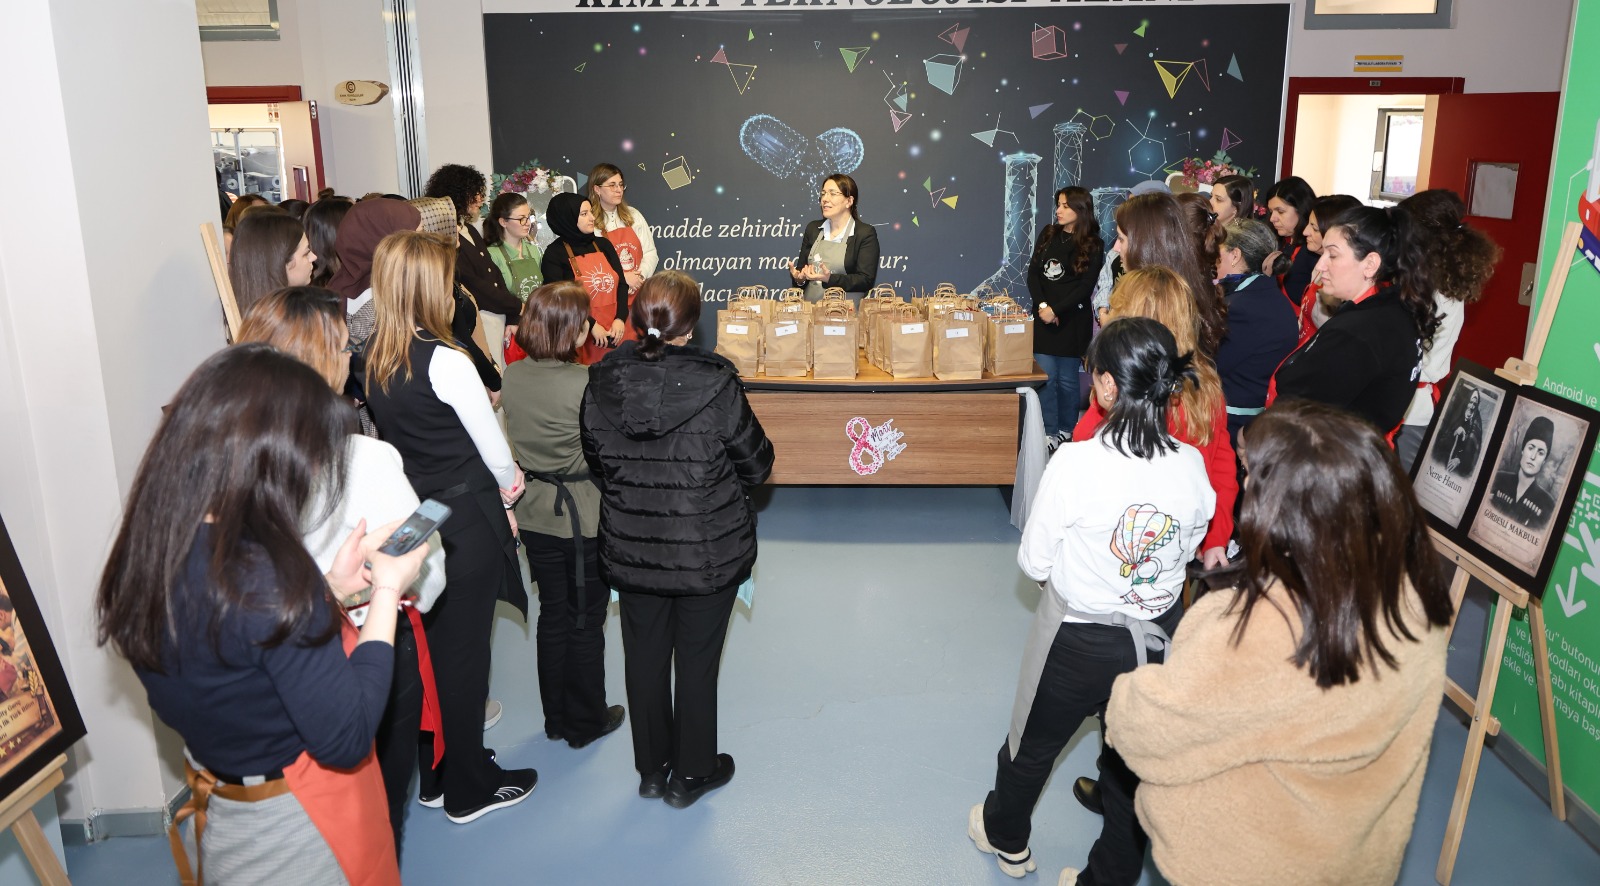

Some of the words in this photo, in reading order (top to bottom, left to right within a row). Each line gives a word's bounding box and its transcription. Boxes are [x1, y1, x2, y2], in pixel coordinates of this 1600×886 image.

[650, 218, 713, 239] madde
[718, 216, 804, 238] zehirdir.
[663, 250, 752, 277] olmayan
[698, 282, 733, 302] lacı
[1543, 377, 1583, 402] Android
[1585, 394, 1598, 408] ve
[1426, 465, 1443, 482] Nene
[1442, 474, 1462, 494] Hatun
[1508, 524, 1540, 547] MAKBULE
[1516, 626, 1526, 640] ve
[1506, 636, 1535, 667] ilediği
[1569, 684, 1600, 719] kitaplı
[1503, 656, 1522, 676] ekle
[1523, 671, 1534, 686] ve
[1553, 695, 1580, 723] maya
[1582, 715, 1600, 741] baş
